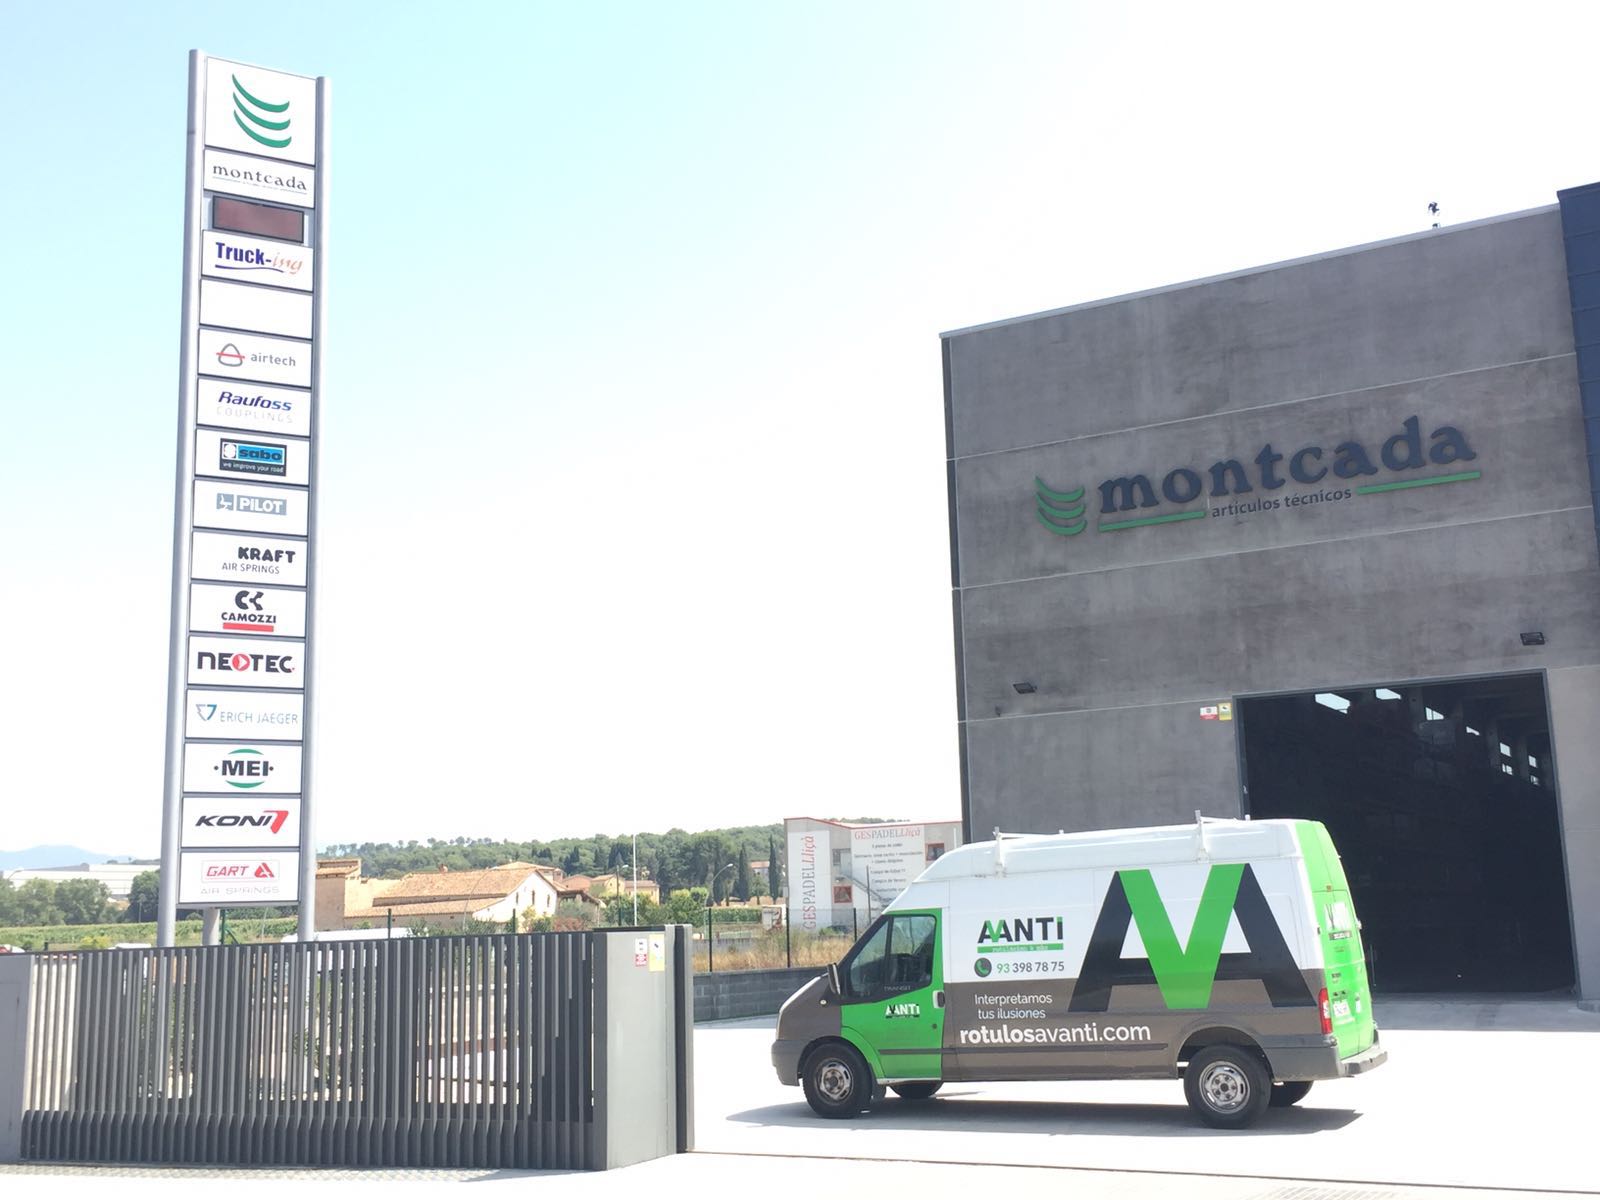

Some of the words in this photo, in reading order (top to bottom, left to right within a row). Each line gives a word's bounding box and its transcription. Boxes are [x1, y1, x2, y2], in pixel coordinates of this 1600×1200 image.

[212, 164, 307, 191] montcada
[250, 352, 297, 367] airtech
[218, 391, 293, 412] Raufoss
[238, 448, 283, 461] sabo
[1098, 415, 1478, 514] montcada
[238, 496, 284, 514] PILOT
[237, 546, 296, 563] KRAFT
[221, 562, 238, 572] AIR
[240, 563, 280, 575] SPRINGS
[221, 611, 277, 624] CAMOZZI
[220, 711, 253, 723] ERICH
[256, 711, 299, 725] JAEGER
[221, 759, 269, 777] MEI
[195, 815, 273, 827] KONI
[206, 865, 250, 877] GART
[996, 963, 1010, 974] 93
[1012, 962, 1033, 974] 398
[1035, 961, 1049, 973] 78
[1051, 961, 1065, 973] 75
[974, 993, 1053, 1007] Interpretamos
[978, 1009, 995, 1020] tus
[997, 1008, 1047, 1020] ilusiones
[959, 1021, 1151, 1045] rotulosavanti.com
